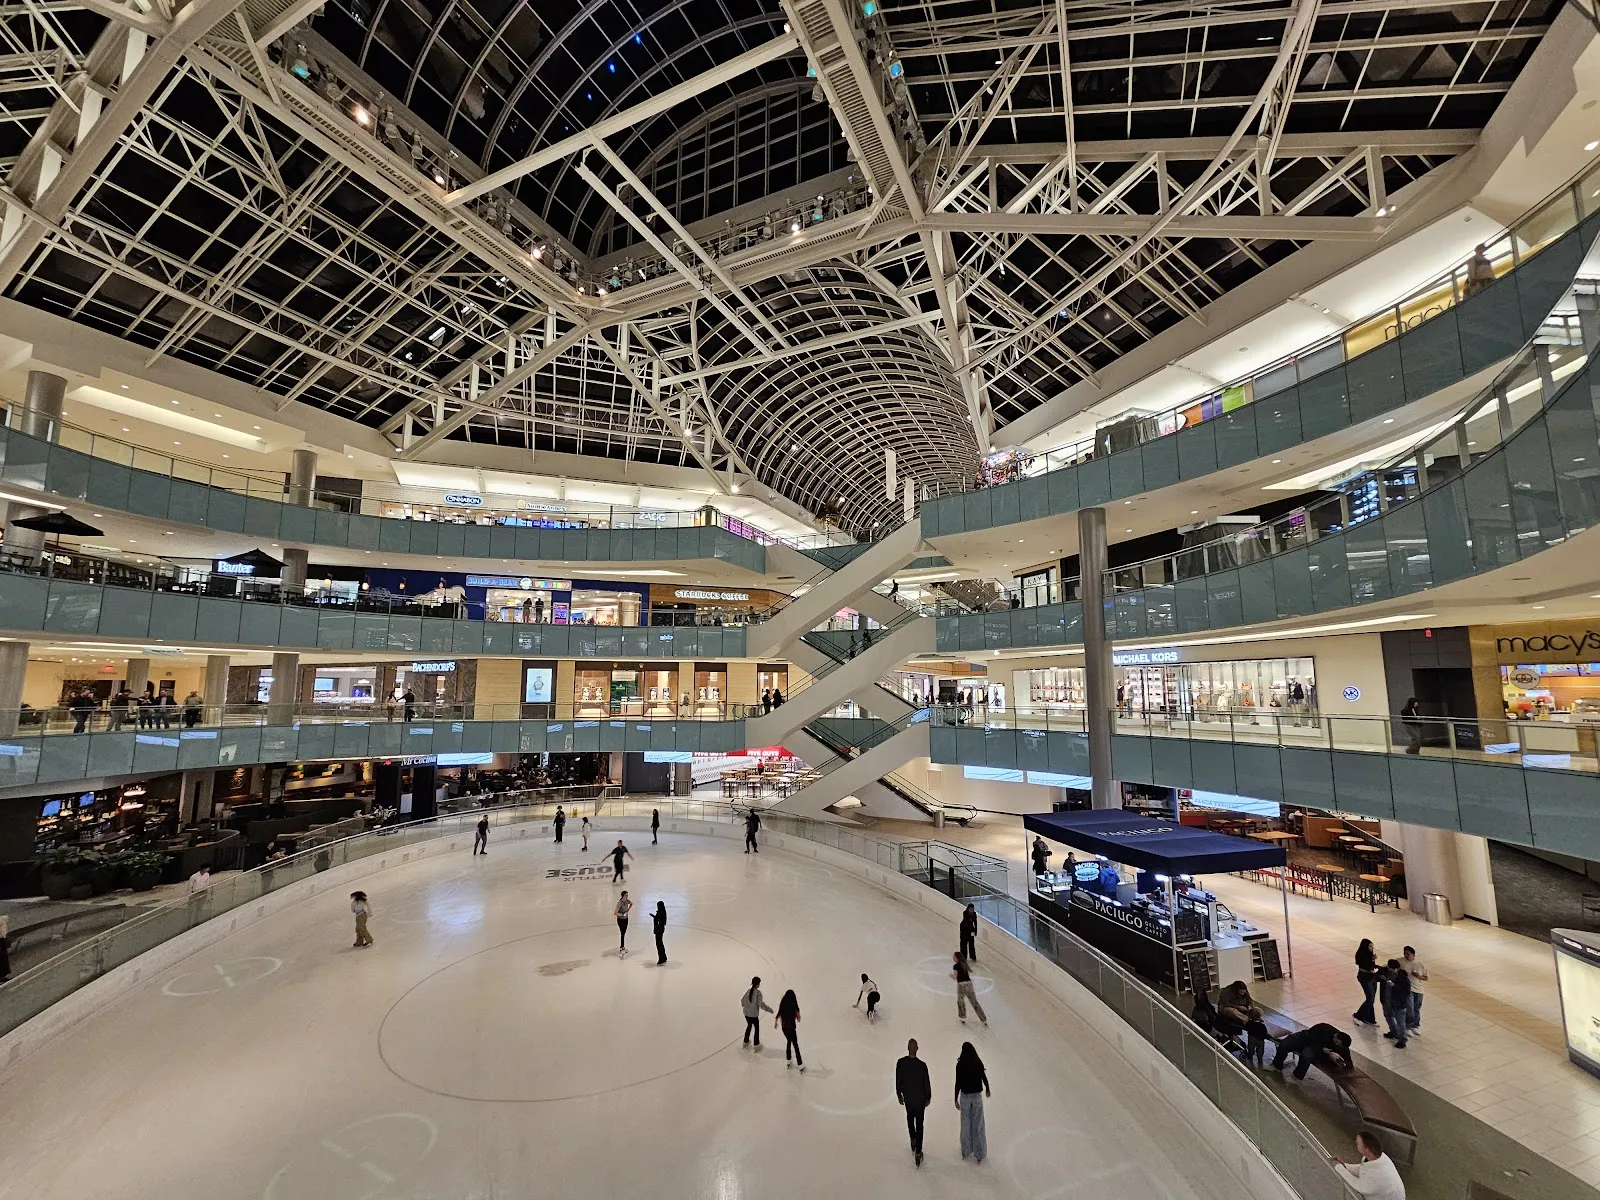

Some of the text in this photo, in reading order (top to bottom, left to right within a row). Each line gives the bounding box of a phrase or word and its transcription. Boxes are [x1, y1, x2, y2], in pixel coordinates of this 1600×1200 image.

[446, 495, 481, 505] CINNABON
[638, 512, 666, 522] ZAGG
[217, 560, 254, 574] Banter
[1027, 576, 1042, 584] KAY
[675, 590, 750, 601] STARBUCKS COFFEE
[1496, 630, 1600, 656] macy's
[1113, 651, 1178, 665] MICHAEL KORS
[412, 661, 456, 672] BACHENDORF'S
[1075, 862, 1099, 870] PACIUGO
[1095, 900, 1143, 929] PACIUGO
[1144, 920, 1168, 934] GELATO
